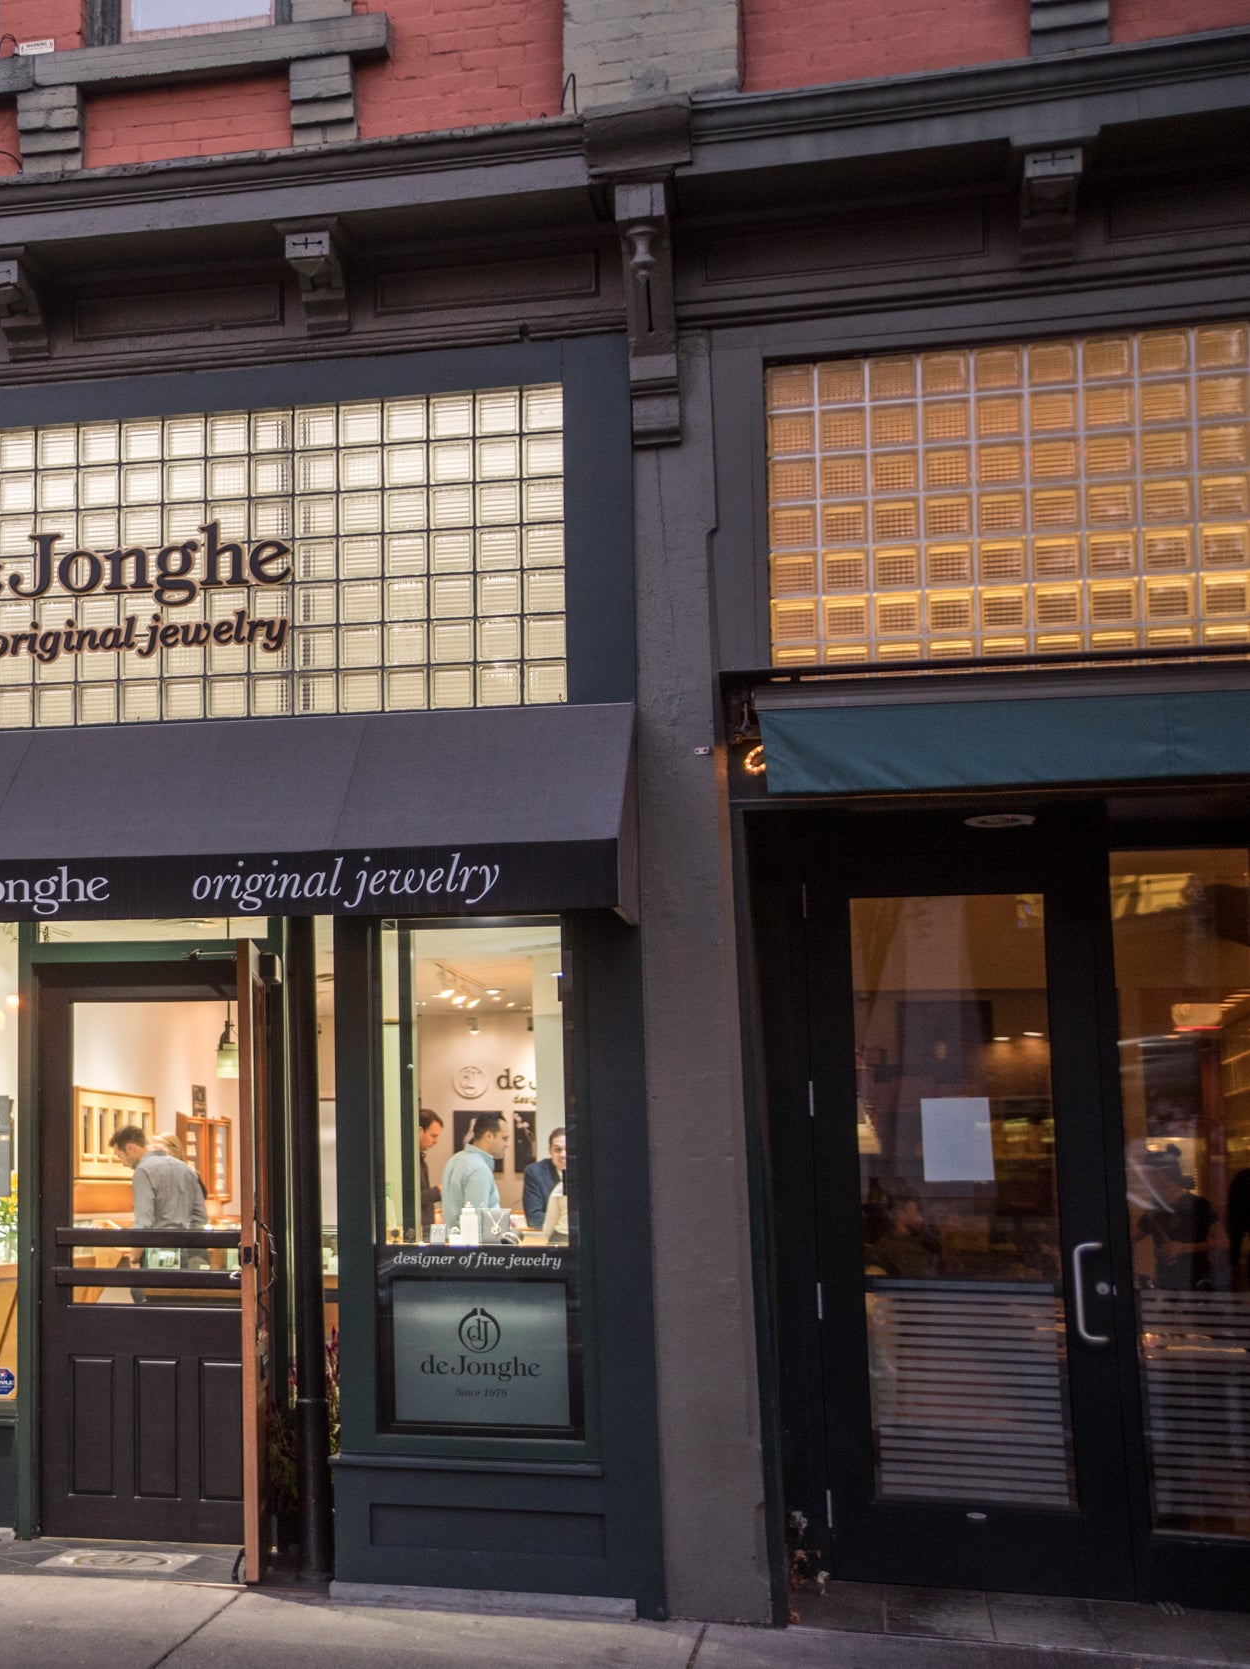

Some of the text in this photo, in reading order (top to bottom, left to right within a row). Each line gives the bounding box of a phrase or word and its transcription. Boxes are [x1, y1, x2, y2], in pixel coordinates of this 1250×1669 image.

[137, 608, 290, 658] jewelry
[192, 852, 501, 912] original jewelry
[393, 1252, 562, 1270] designer of fine jewelry
[455, 1387, 481, 1397] Since
